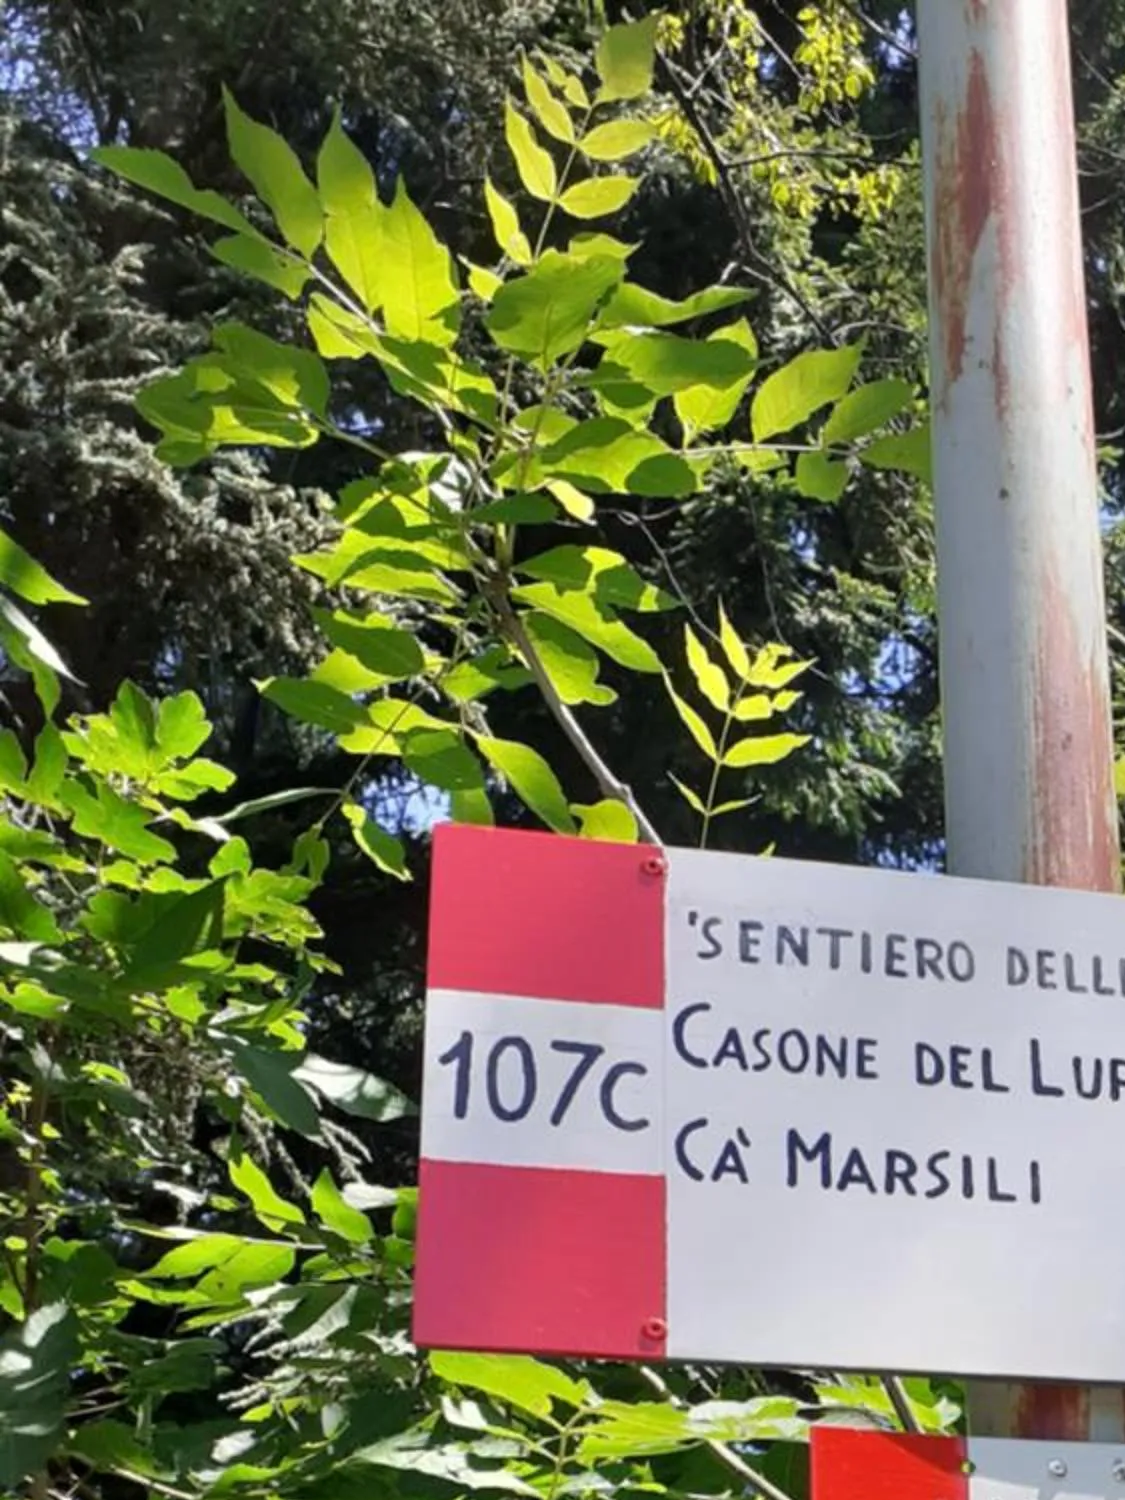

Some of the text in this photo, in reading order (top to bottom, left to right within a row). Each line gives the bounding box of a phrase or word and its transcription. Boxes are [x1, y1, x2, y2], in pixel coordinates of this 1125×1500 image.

[672, 1003, 879, 1081] CASONE
[915, 1041, 1010, 1094] DEL
[786, 1128, 1041, 1205] MARSILI
